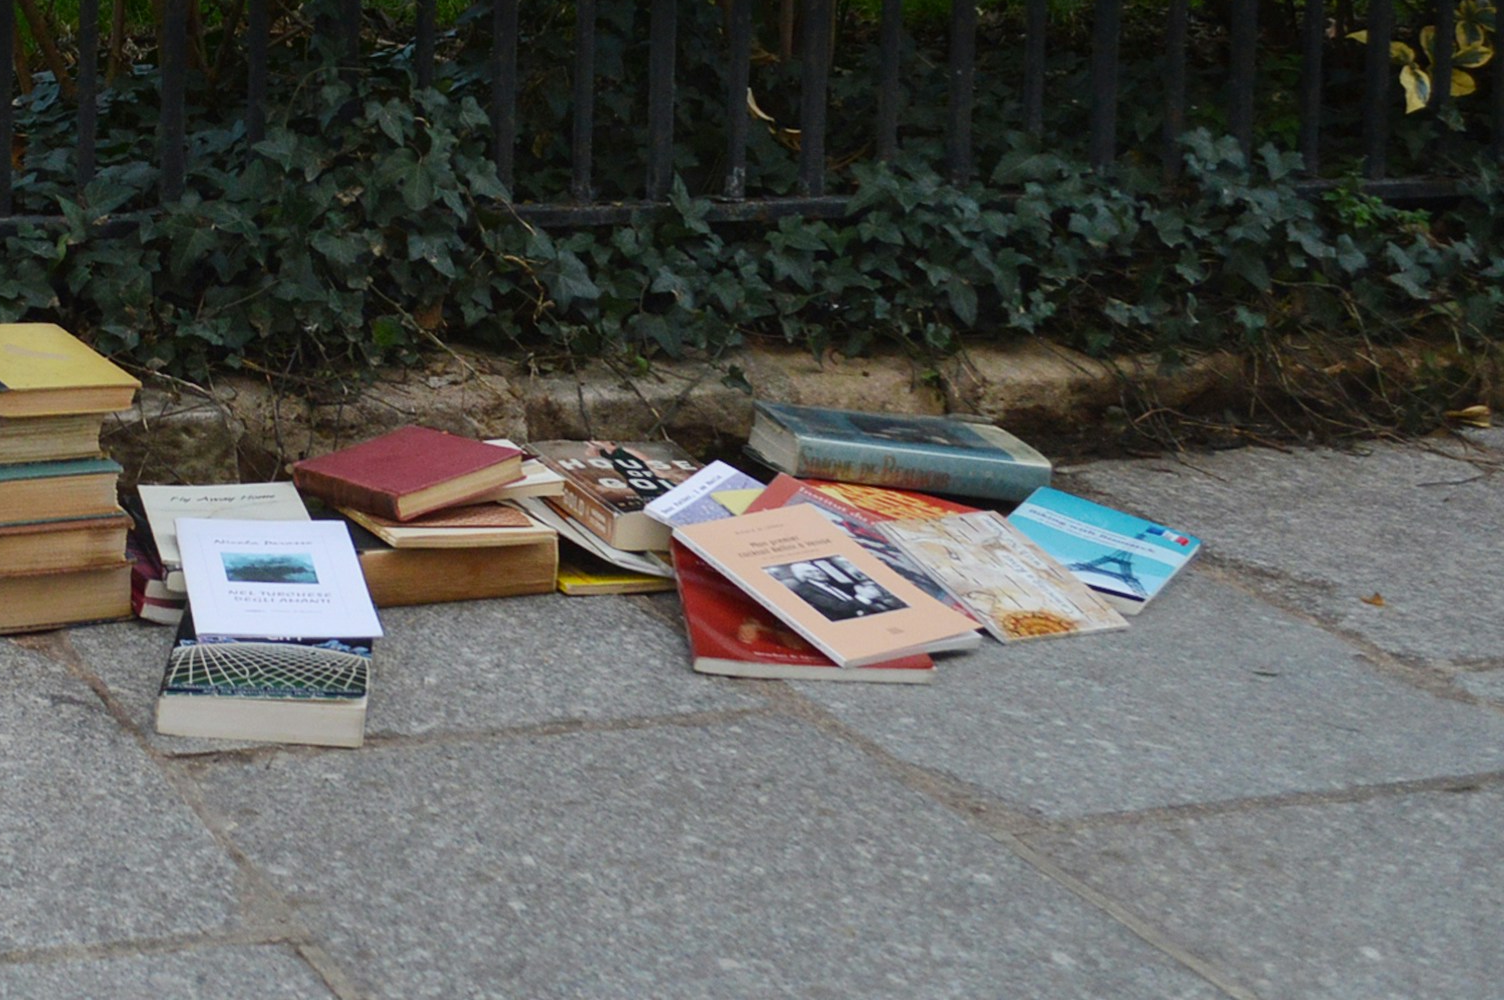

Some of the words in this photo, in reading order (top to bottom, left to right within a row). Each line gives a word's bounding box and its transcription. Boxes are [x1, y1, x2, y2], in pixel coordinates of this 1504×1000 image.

[558, 458, 698, 471] HOUSE
[626, 469, 655, 478] OF
[598, 477, 678, 490] GOL
[170, 495, 191, 504] Fly
[196, 494, 236, 503] Away
[240, 493, 276, 501] Home
